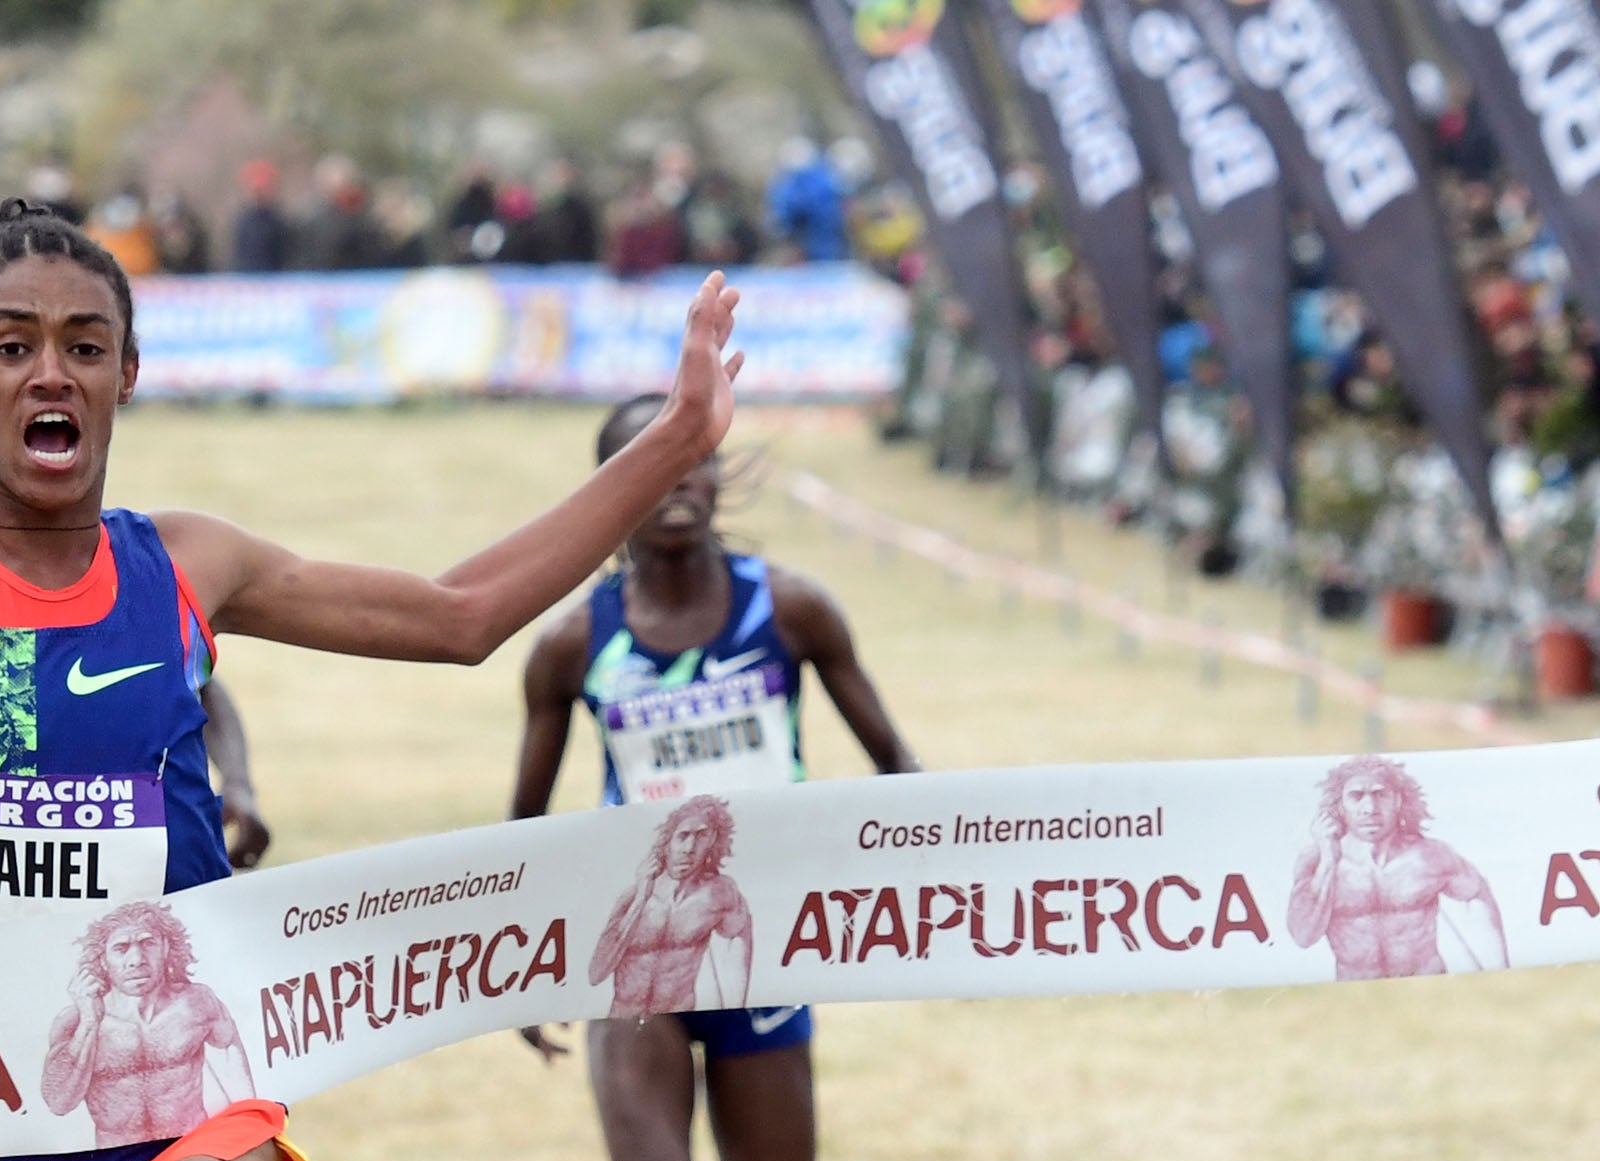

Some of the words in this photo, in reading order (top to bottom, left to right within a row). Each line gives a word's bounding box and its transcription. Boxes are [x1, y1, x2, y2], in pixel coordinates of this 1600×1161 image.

[859, 820, 942, 850] Cross
[953, 806, 1164, 845] Internacional
[284, 903, 349, 939] Cross
[356, 861, 526, 921] Internacional
[781, 873, 1272, 967] ATAPUERCA
[261, 918, 567, 1069] ATAPUERCA
